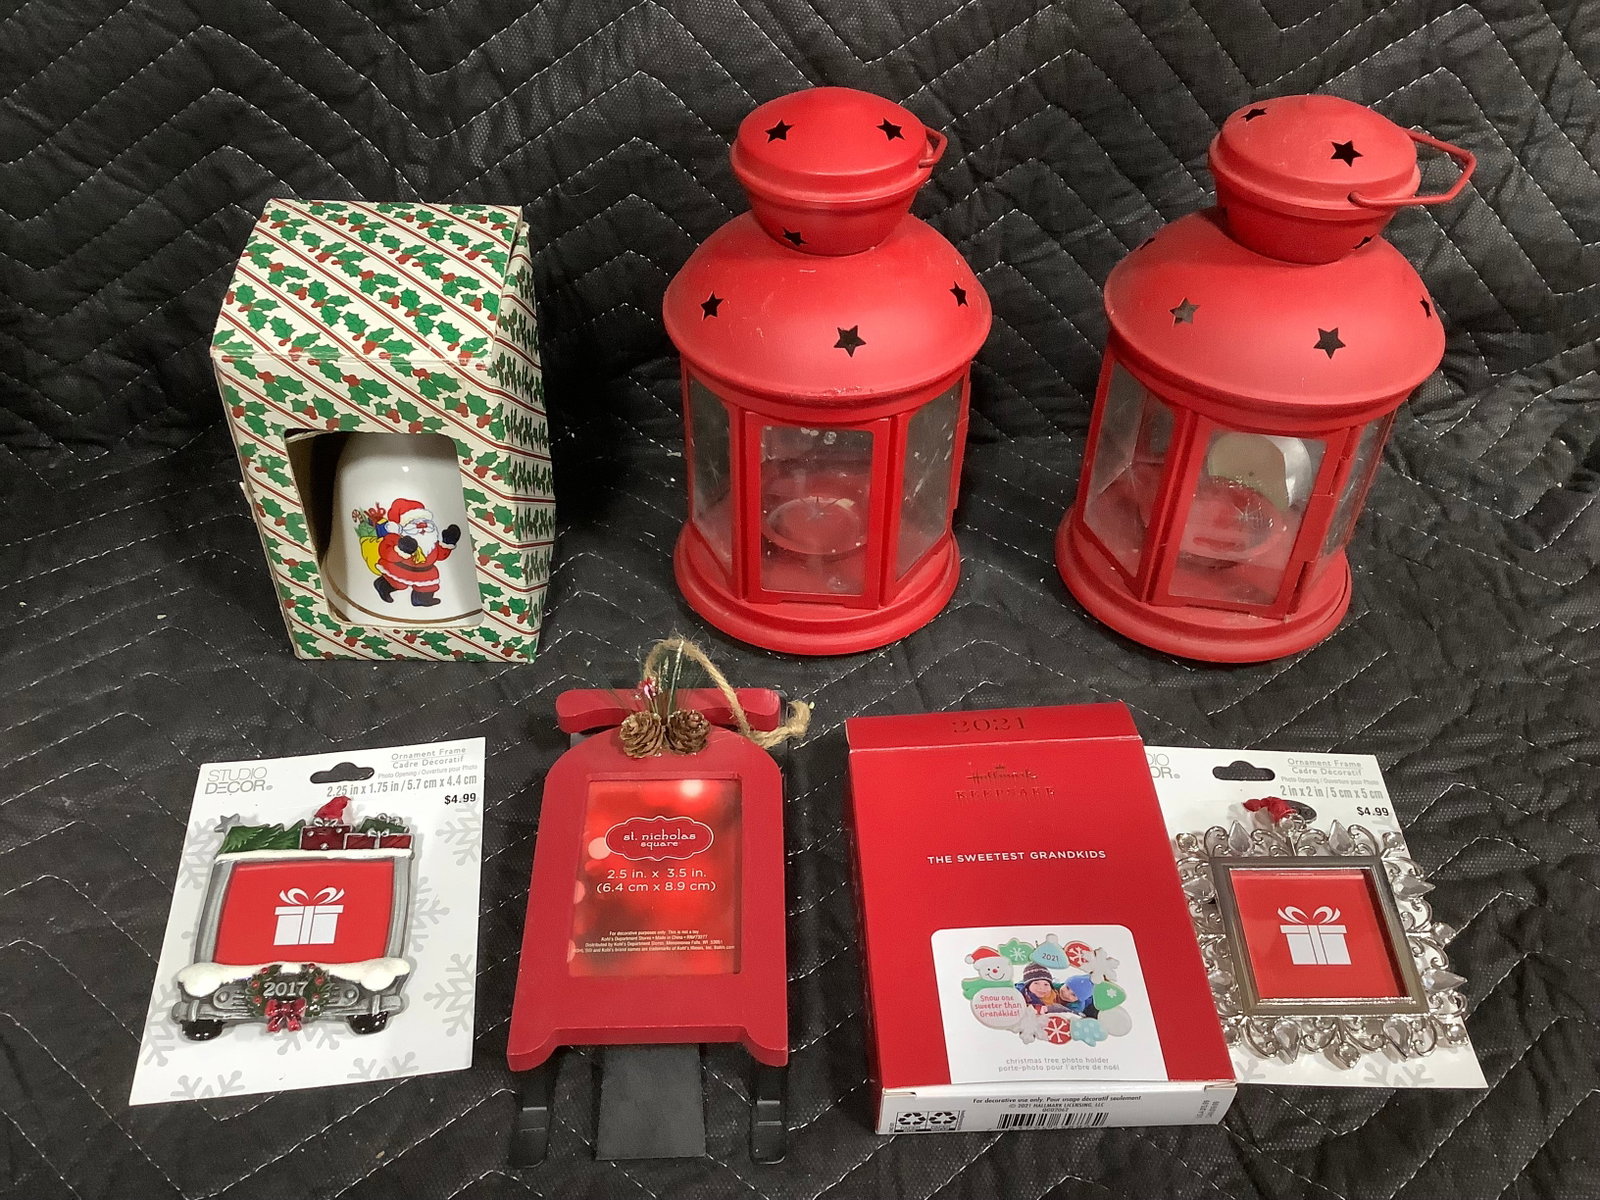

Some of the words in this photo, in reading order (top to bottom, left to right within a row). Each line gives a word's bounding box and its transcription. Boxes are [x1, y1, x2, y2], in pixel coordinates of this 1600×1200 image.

[951, 717, 1024, 733] 2021
[391, 751, 436, 761] Ornament
[439, 747, 467, 757] Frame
[393, 760, 419, 770] Cadre
[422, 755, 464, 768] Décoratif
[1287, 758, 1332, 767] Ornament
[1334, 760, 1362, 769] Frame
[207, 767, 268, 783] STUDIO
[1291, 767, 1318, 776] Cadre
[326, 785, 348, 798] 2.25
[350, 783, 359, 795] in
[360, 783, 368, 794] x
[369, 780, 389, 794] 1.75
[390, 779, 399, 792] in
[400, 780, 407, 793] /
[407, 778, 423, 791] 5.7
[423, 779, 438, 790] cm
[439, 777, 446, 788] x
[447, 774, 462, 787] 4.4
[463, 774, 478, 786] cm
[1279, 785, 1288, 797] 2
[1289, 786, 1299, 797] in
[1300, 789, 1305, 797] x
[1306, 786, 1313, 797] 2
[1314, 786, 1324, 797] in
[1331, 787, 1337, 799] 5
[1338, 789, 1353, 799] cm
[1355, 790, 1361, 799] x
[1361, 788, 1368, 799] 5
[1369, 790, 1384, 799] cm
[444, 792, 478, 806] $4.99
[1356, 806, 1390, 817] $4.99
[623, 831, 638, 841] st.
[641, 828, 697, 841] nicholas
[640, 840, 679, 850] square
[927, 855, 953, 865] THE
[956, 851, 1026, 864] SWEETEST
[1029, 849, 1107, 861] GRANDKIDS
[607, 869, 627, 880] 2.5
[632, 868, 647, 879] in.
[651, 870, 660, 879] x
[667, 868, 687, 879] 3.5
[691, 867, 707, 878] in.
[596, 882, 624, 894] (6.4
[628, 883, 649, 892] cm
[653, 883, 661, 891] x
[664, 881, 686, 892] 8.9
[689, 880, 717, 892] cm)
[1041, 953, 1059, 963] 2021
[263, 981, 309, 997] 2017
[980, 994, 1000, 1003] Snow
[974, 1002, 1003, 1010] sweeter
[1003, 1001, 1023, 1009] than
[1006, 1057, 1042, 1065] christmas
[1061, 1056, 1083, 1066] photo
[1085, 1056, 1109, 1064] holder
[998, 1064, 1044, 1073] porte-photo
[1092, 1063, 1102, 1071] de
